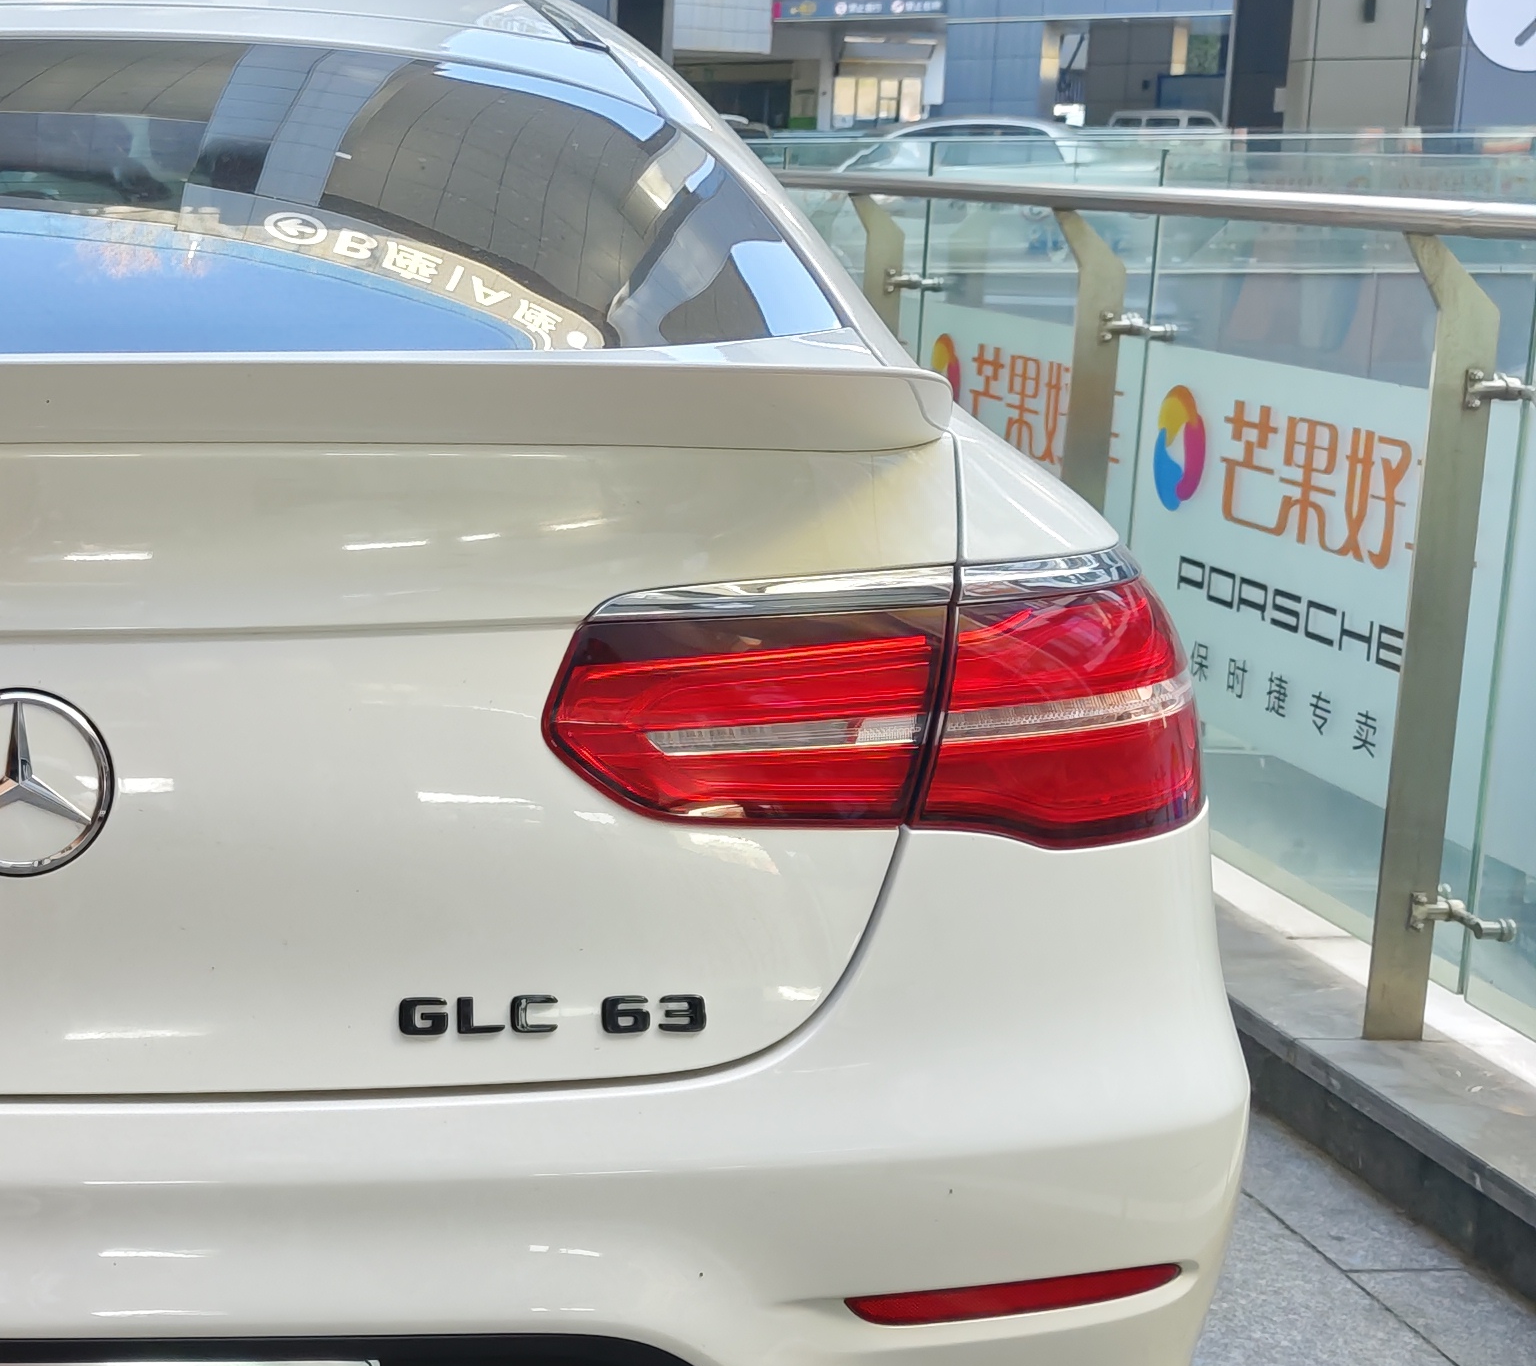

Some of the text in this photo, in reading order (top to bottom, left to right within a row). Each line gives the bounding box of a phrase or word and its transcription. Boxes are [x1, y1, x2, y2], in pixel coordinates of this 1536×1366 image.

[1220, 399, 1418, 570] 芒果好
[1177, 555, 1405, 673] PORSCHE
[1190, 641, 1377, 758] 保时捷专卖
[399, 995, 707, 1035] GLC 63
